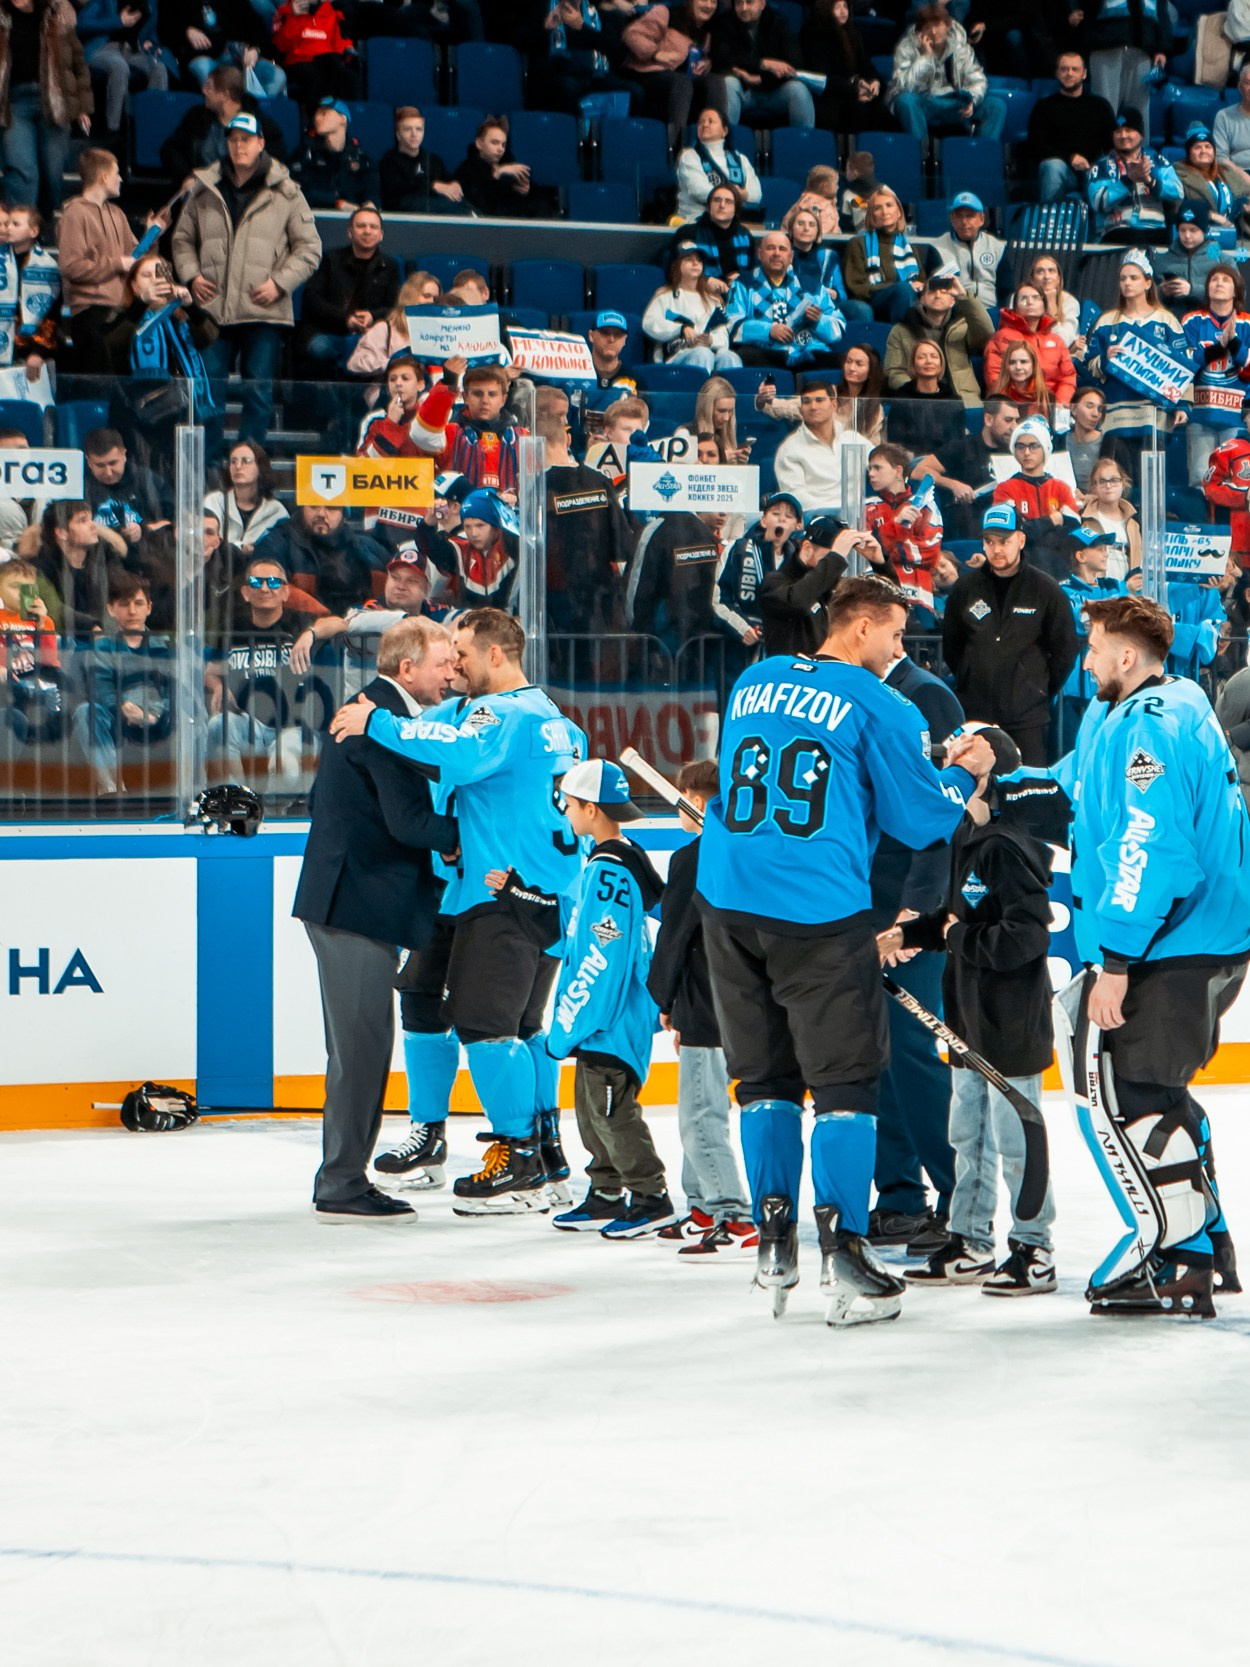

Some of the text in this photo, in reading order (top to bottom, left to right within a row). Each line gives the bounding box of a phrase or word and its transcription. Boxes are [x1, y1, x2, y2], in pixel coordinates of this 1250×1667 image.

[0, 461, 68, 485] газ
[353, 474, 419, 490] БАНК
[688, 474, 716, 483] ФОНБЕТ
[688, 484, 739, 493] НЕДЕЛЯ ЗВЕЗД
[688, 494, 734, 502] ХОККЕЯ 2025
[731, 682, 852, 731] KHAFIZOV
[1126, 763, 1166, 778] ERNYSHEV
[725, 734, 834, 841] 89
[597, 869, 631, 908] 52
[9, 947, 104, 996] НА
[1089, 1071, 1098, 1107] ULTRA
